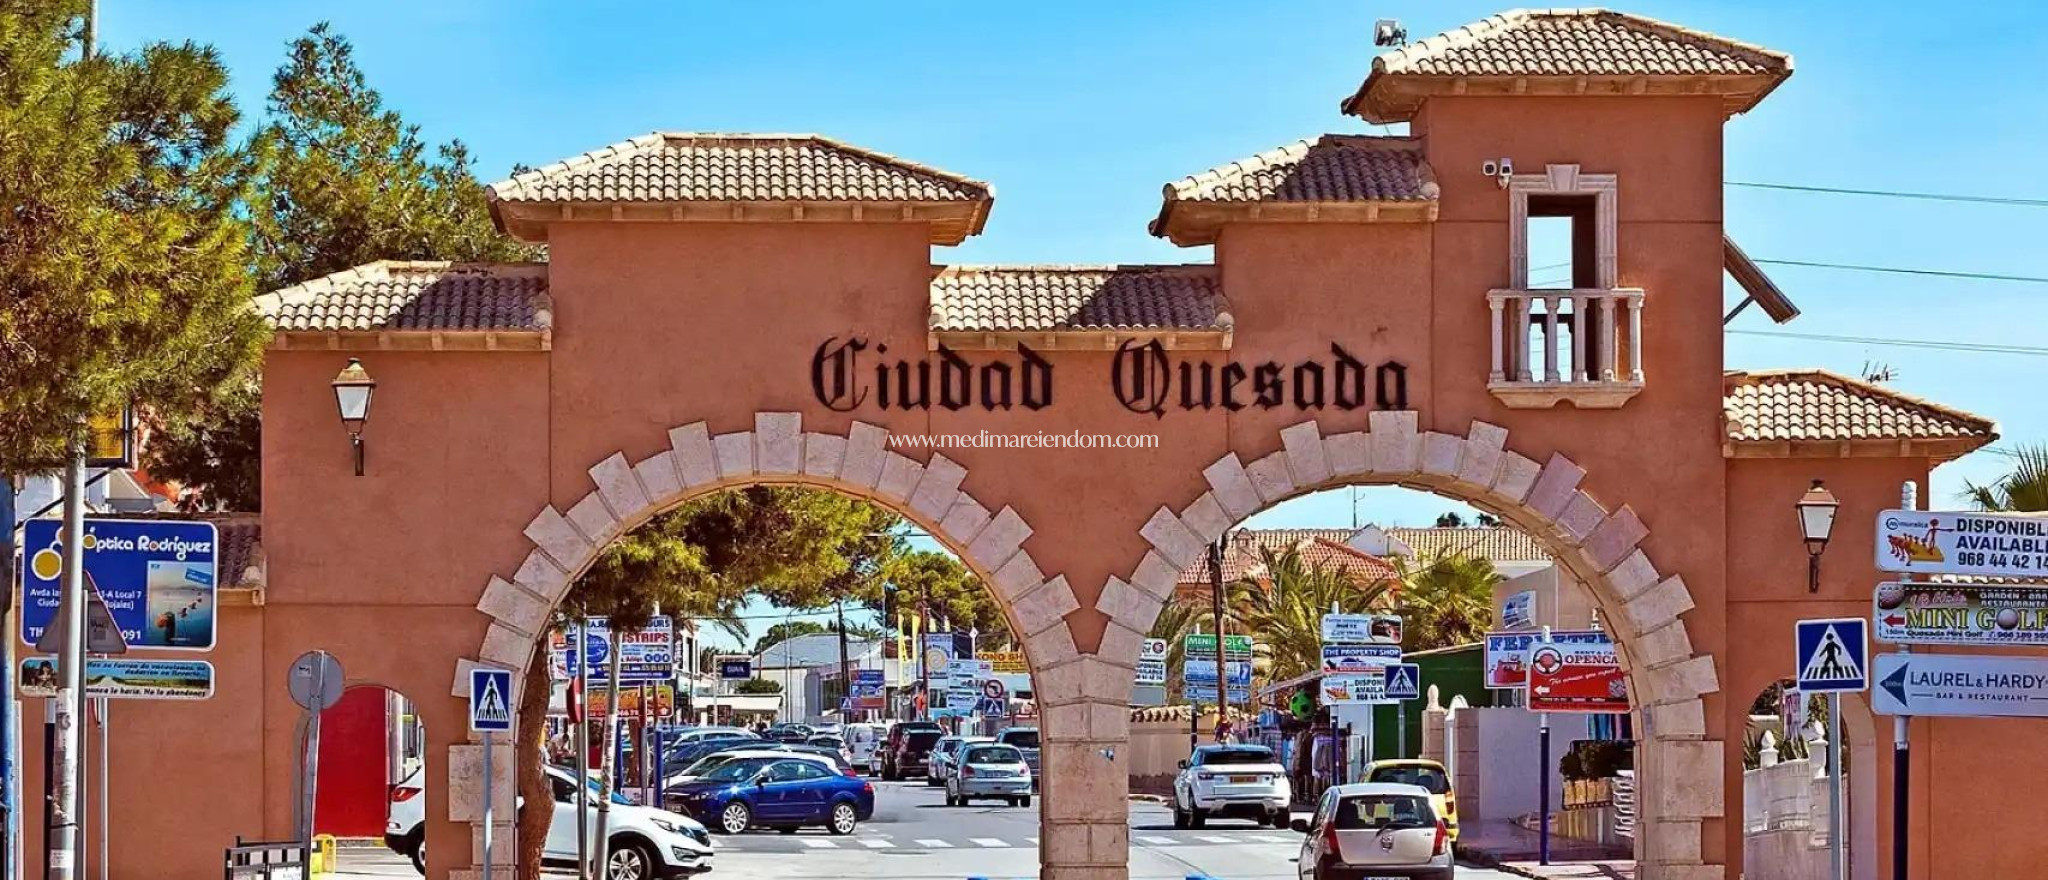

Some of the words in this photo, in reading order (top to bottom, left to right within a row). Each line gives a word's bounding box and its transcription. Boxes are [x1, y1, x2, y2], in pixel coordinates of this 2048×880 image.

[811, 337, 1055, 412] Ciudad
[1112, 337, 1409, 419] Quesada
[138, 535, 211, 560] Rodríguez
[1958, 552, 1984, 566] 968
[1989, 553, 2007, 567] 44
[2012, 554, 2029, 568] 42
[115, 589, 135, 598] Local
[137, 590, 142, 599] 7
[1905, 608, 1970, 629] MINI
[1565, 655, 1618, 664] OPENCA
[1911, 671, 1974, 687] LAUREL
[1976, 678, 1983, 688] &
[1986, 673, 2045, 689] HARDY
[1968, 693, 2028, 702] RESTAURANT
